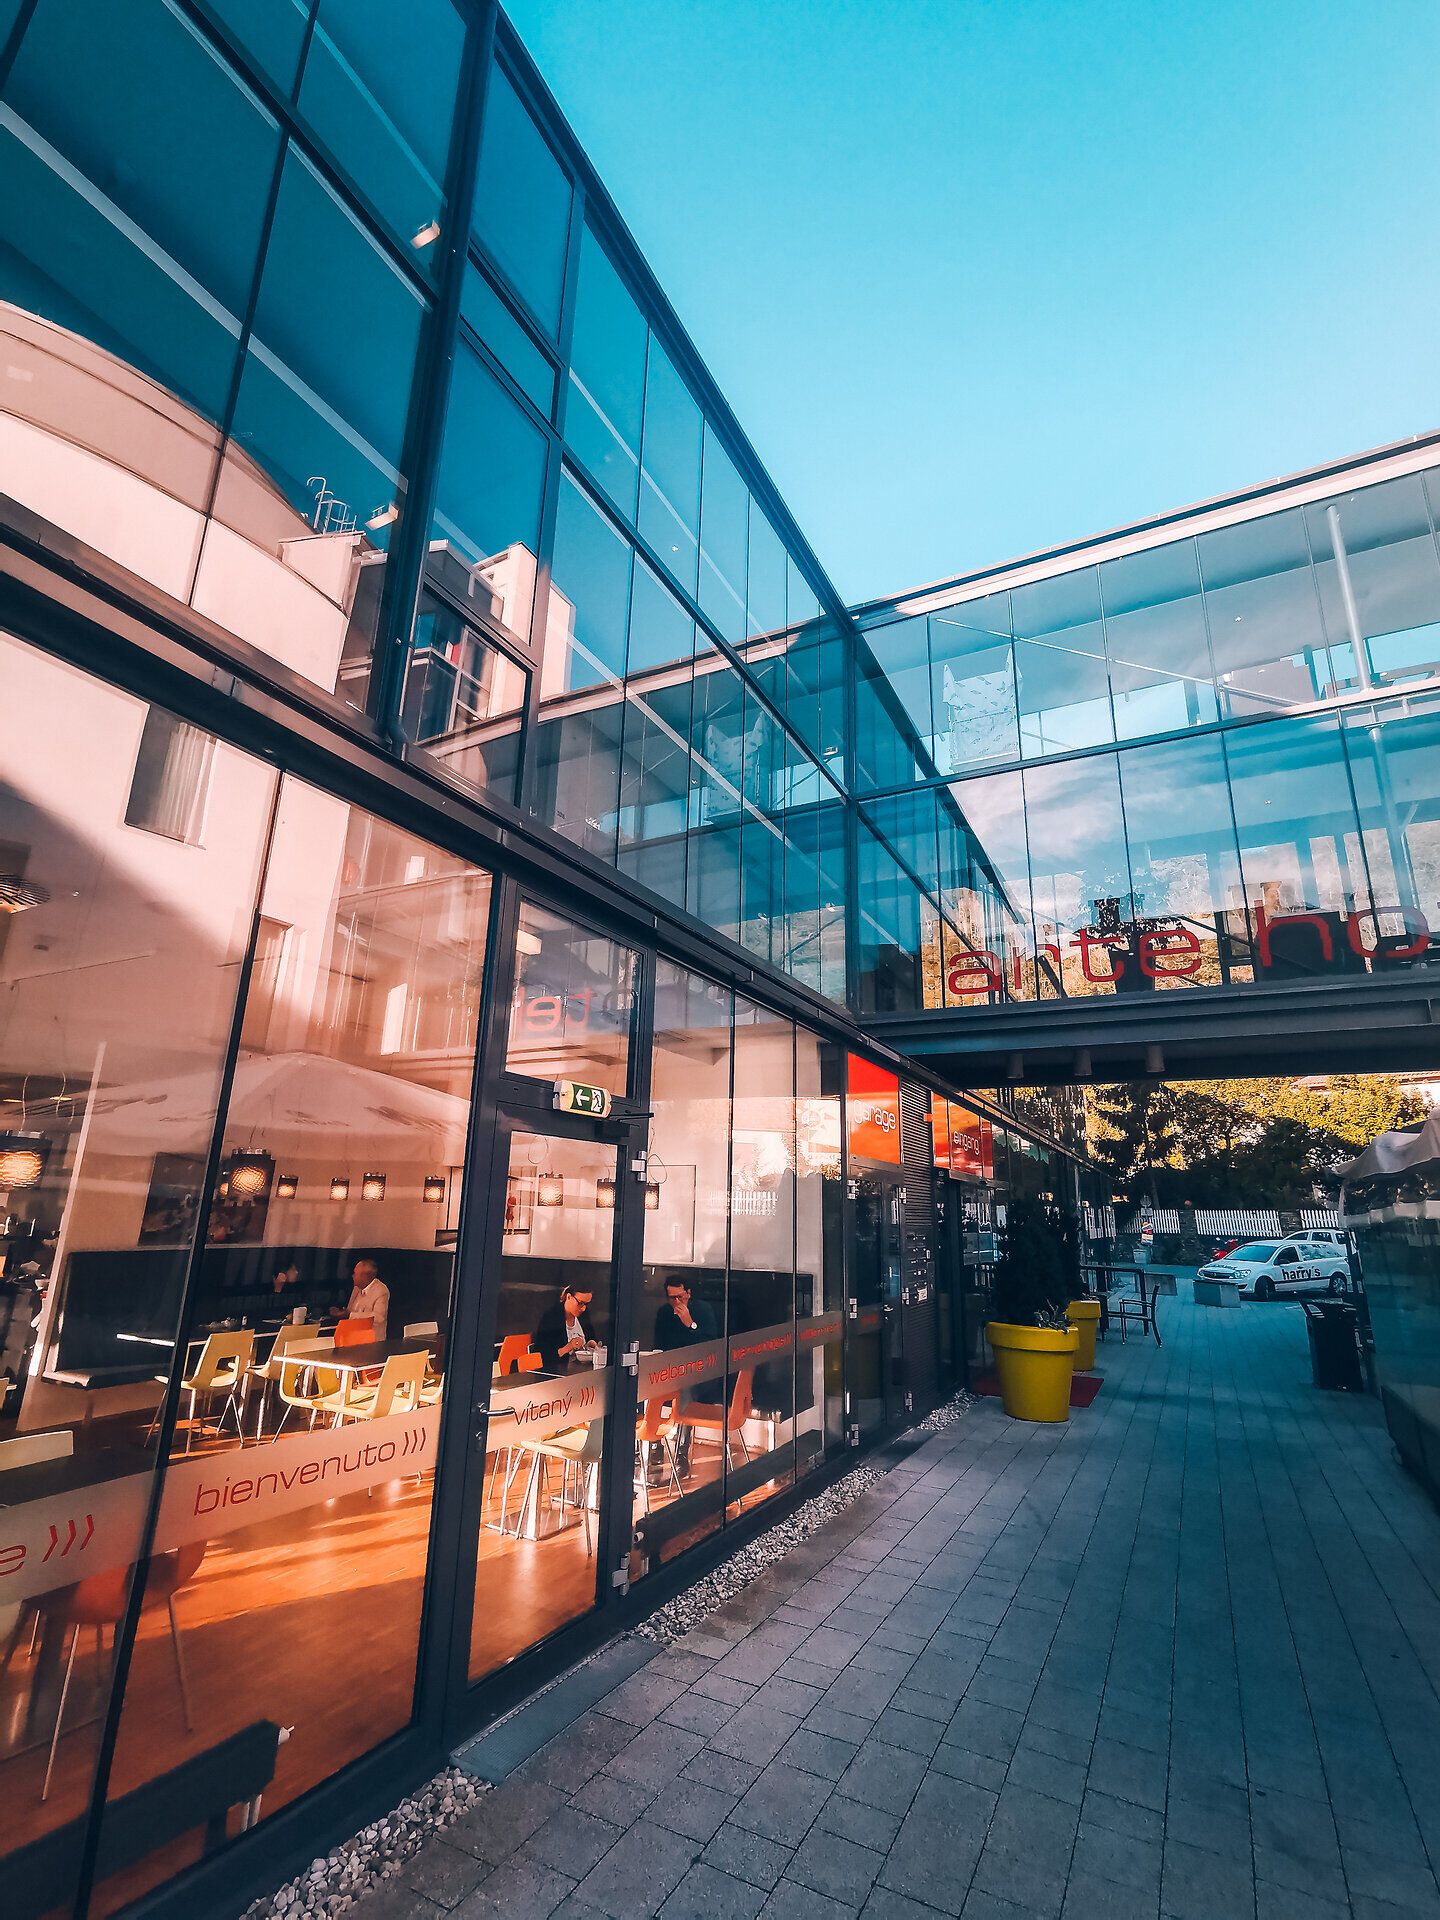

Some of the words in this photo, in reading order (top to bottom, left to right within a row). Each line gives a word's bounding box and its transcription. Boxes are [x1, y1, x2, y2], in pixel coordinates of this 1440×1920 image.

[948, 926, 1202, 996] arte
[1256, 898, 1431, 968] ho
[854, 1099, 897, 1133] garage
[1281, 1265, 1321, 1282] harry's
[648, 1357, 705, 1386] welcome
[514, 1390, 572, 1426] vítaný
[193, 1440, 397, 1516] bienvenuto
